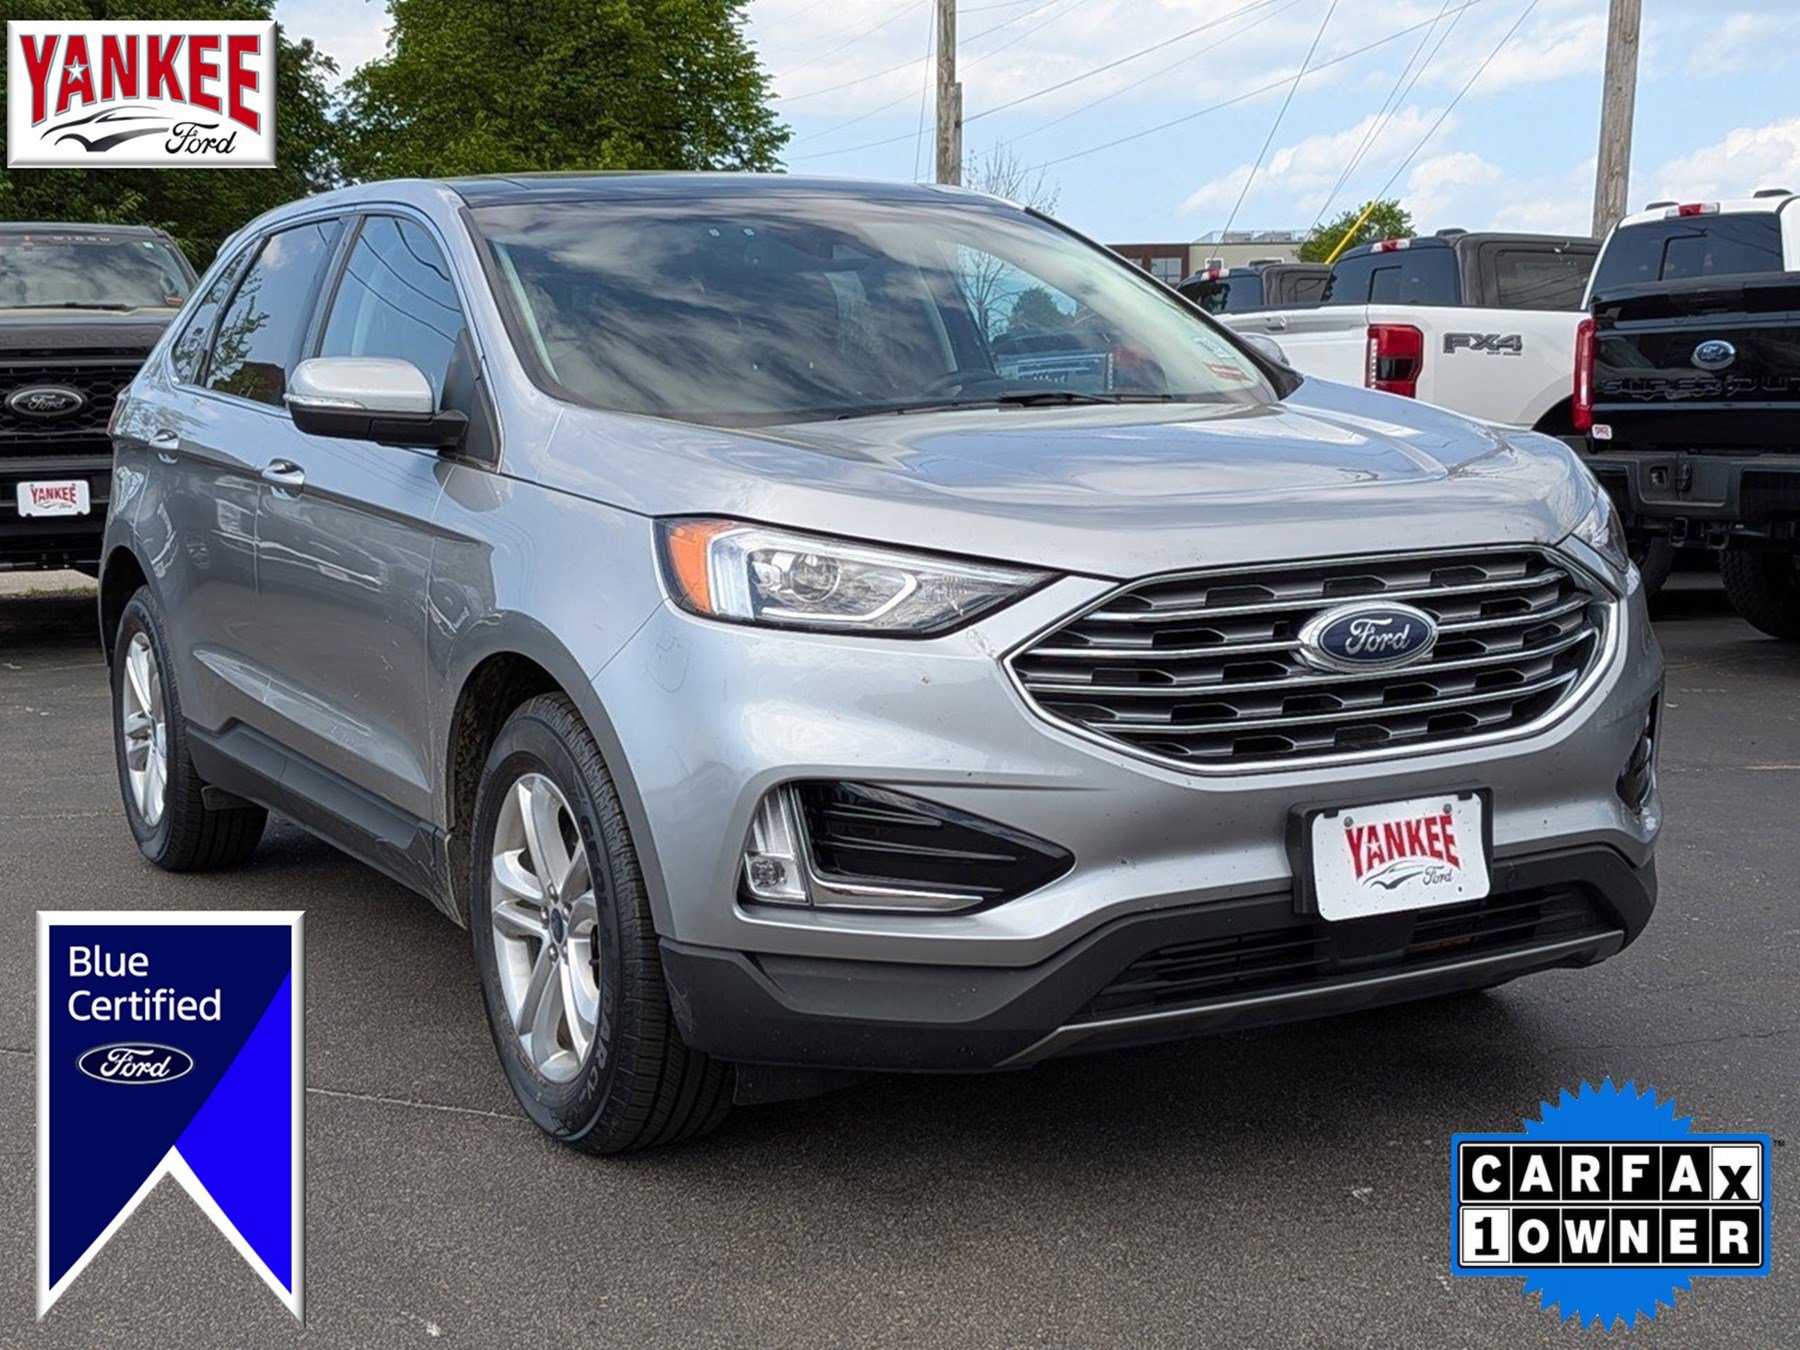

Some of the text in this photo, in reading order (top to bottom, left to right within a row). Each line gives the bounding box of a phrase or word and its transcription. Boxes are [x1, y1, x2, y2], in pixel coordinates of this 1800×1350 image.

[1443, 333, 1522, 353] FX4
[28, 395, 66, 409] Ford
[31, 486, 77, 504] YANKEE
[1345, 618, 1410, 654] Ford
[1344, 814, 1461, 878] YANKEE
[1423, 866, 1452, 885] Ford
